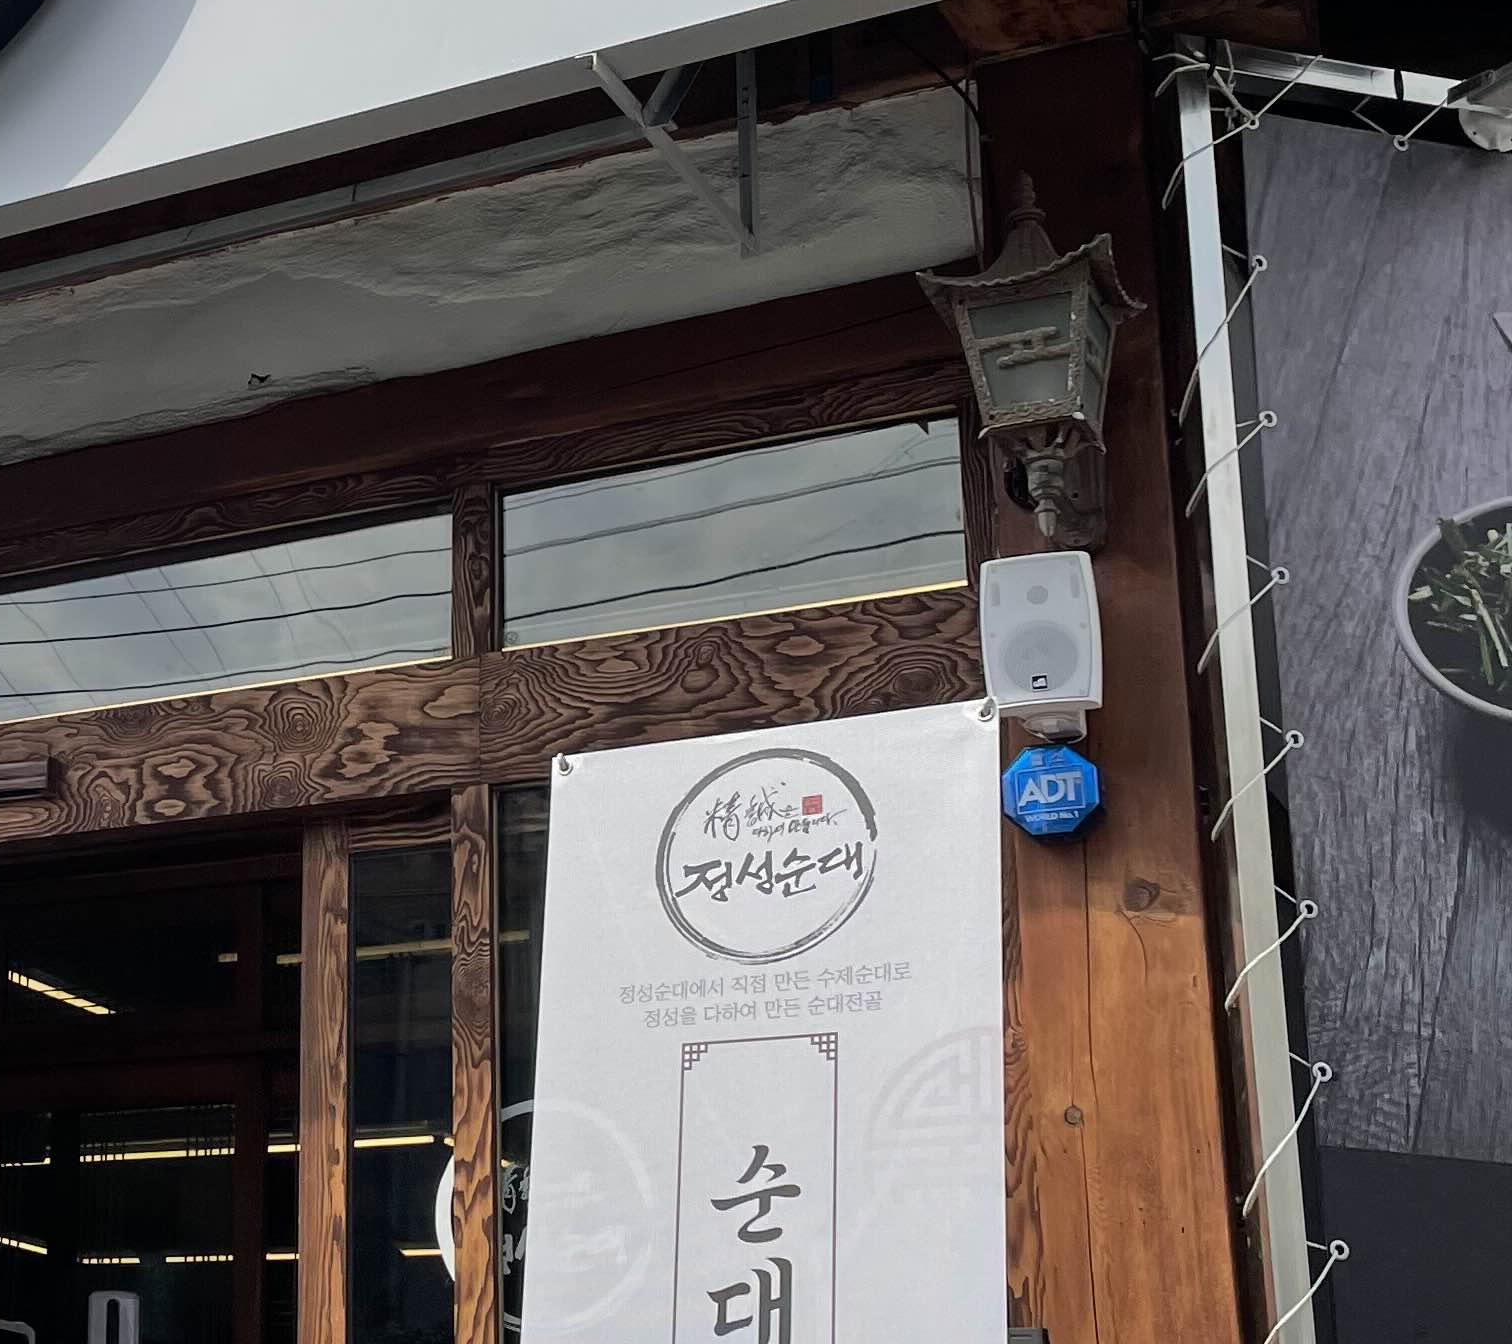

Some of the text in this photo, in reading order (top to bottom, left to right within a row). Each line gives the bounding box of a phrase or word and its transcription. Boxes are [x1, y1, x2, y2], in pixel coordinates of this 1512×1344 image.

[1018, 771, 1081, 806] ADT
[675, 841, 863, 902] 정성순대
[619, 961, 912, 1004] 정성순대에서 직접 만든 수제순대로
[644, 991, 883, 1028] 정성을 다하여 만든 순대전골
